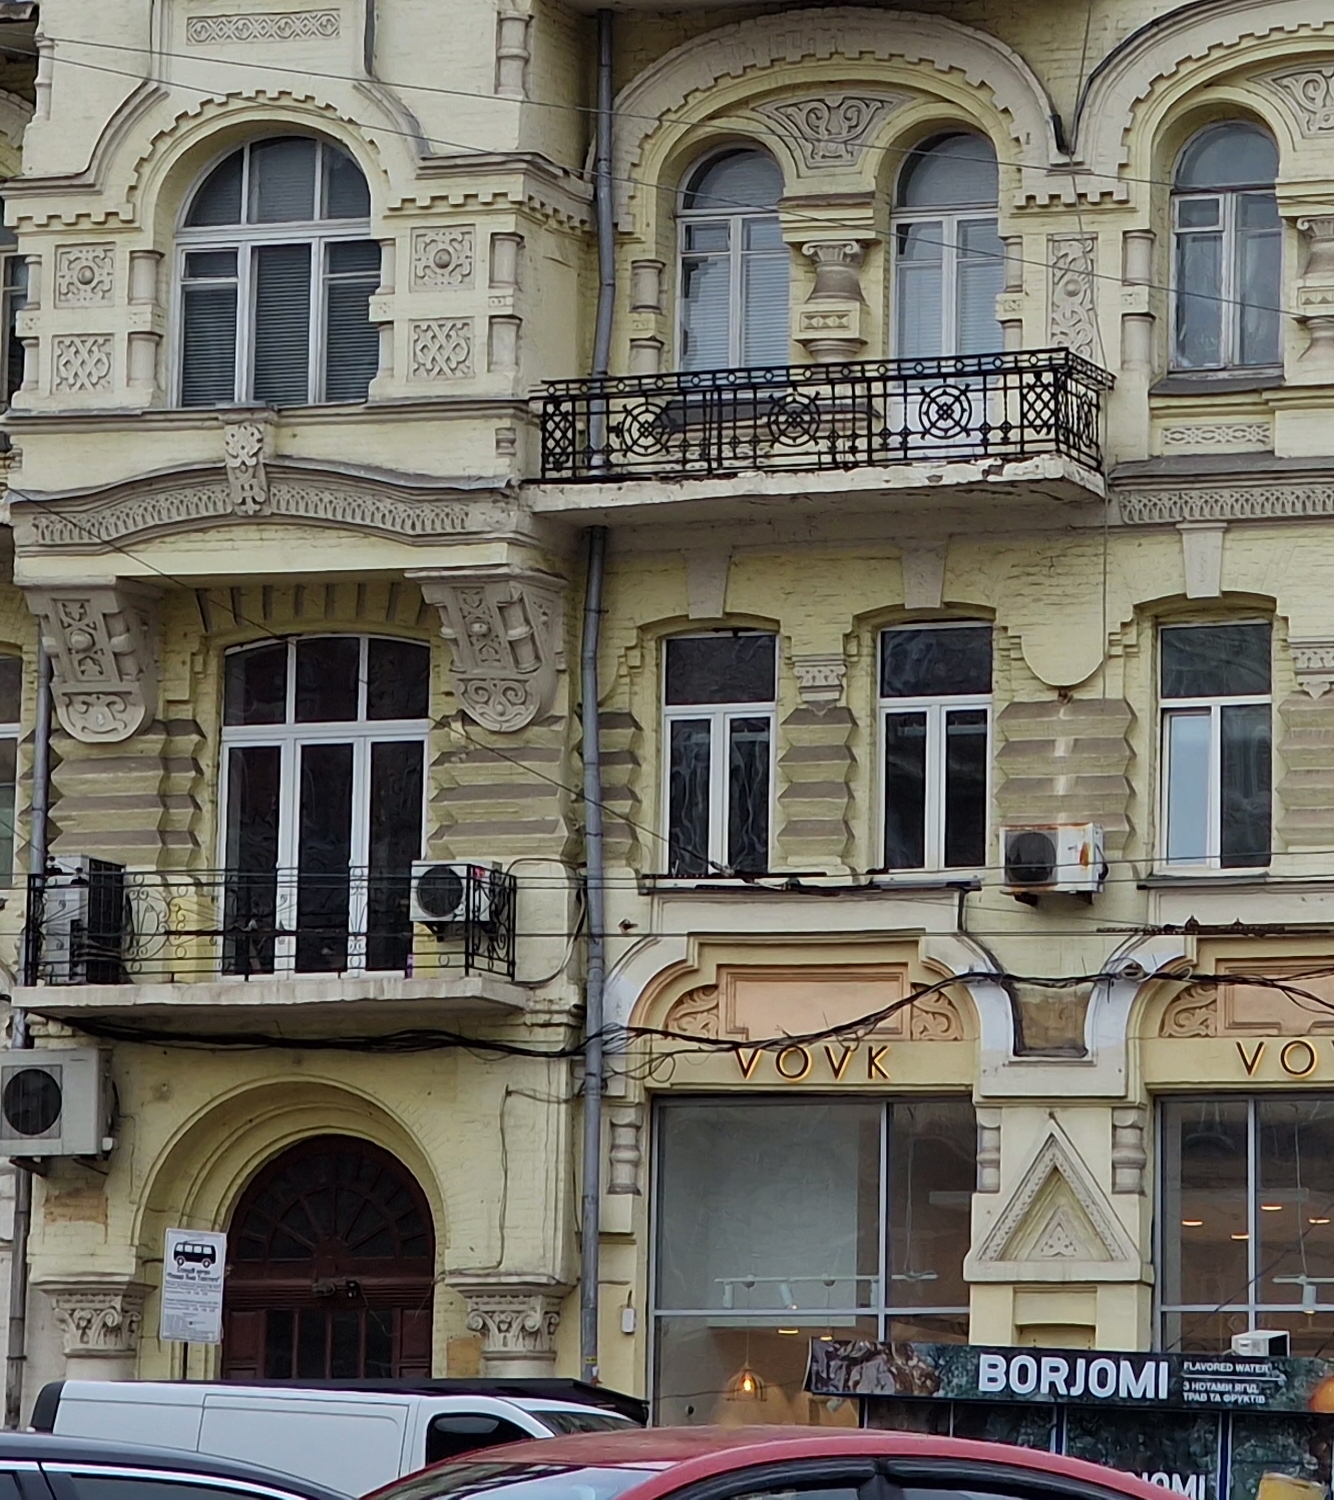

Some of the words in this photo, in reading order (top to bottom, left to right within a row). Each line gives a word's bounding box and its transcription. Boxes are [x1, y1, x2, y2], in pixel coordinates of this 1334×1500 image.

[734, 1045, 891, 1082] VOVK
[1183, 1361, 1234, 1373] FLAVORED
[978, 1353, 1169, 1399] BORJOMI
[1191, 1381, 1233, 1392] НОТАМИ
[1182, 1392, 1208, 1402] ТРАВ
[1209, 1392, 1222, 1402] ТА
[1223, 1393, 1267, 1405] ФРУКТІВ
